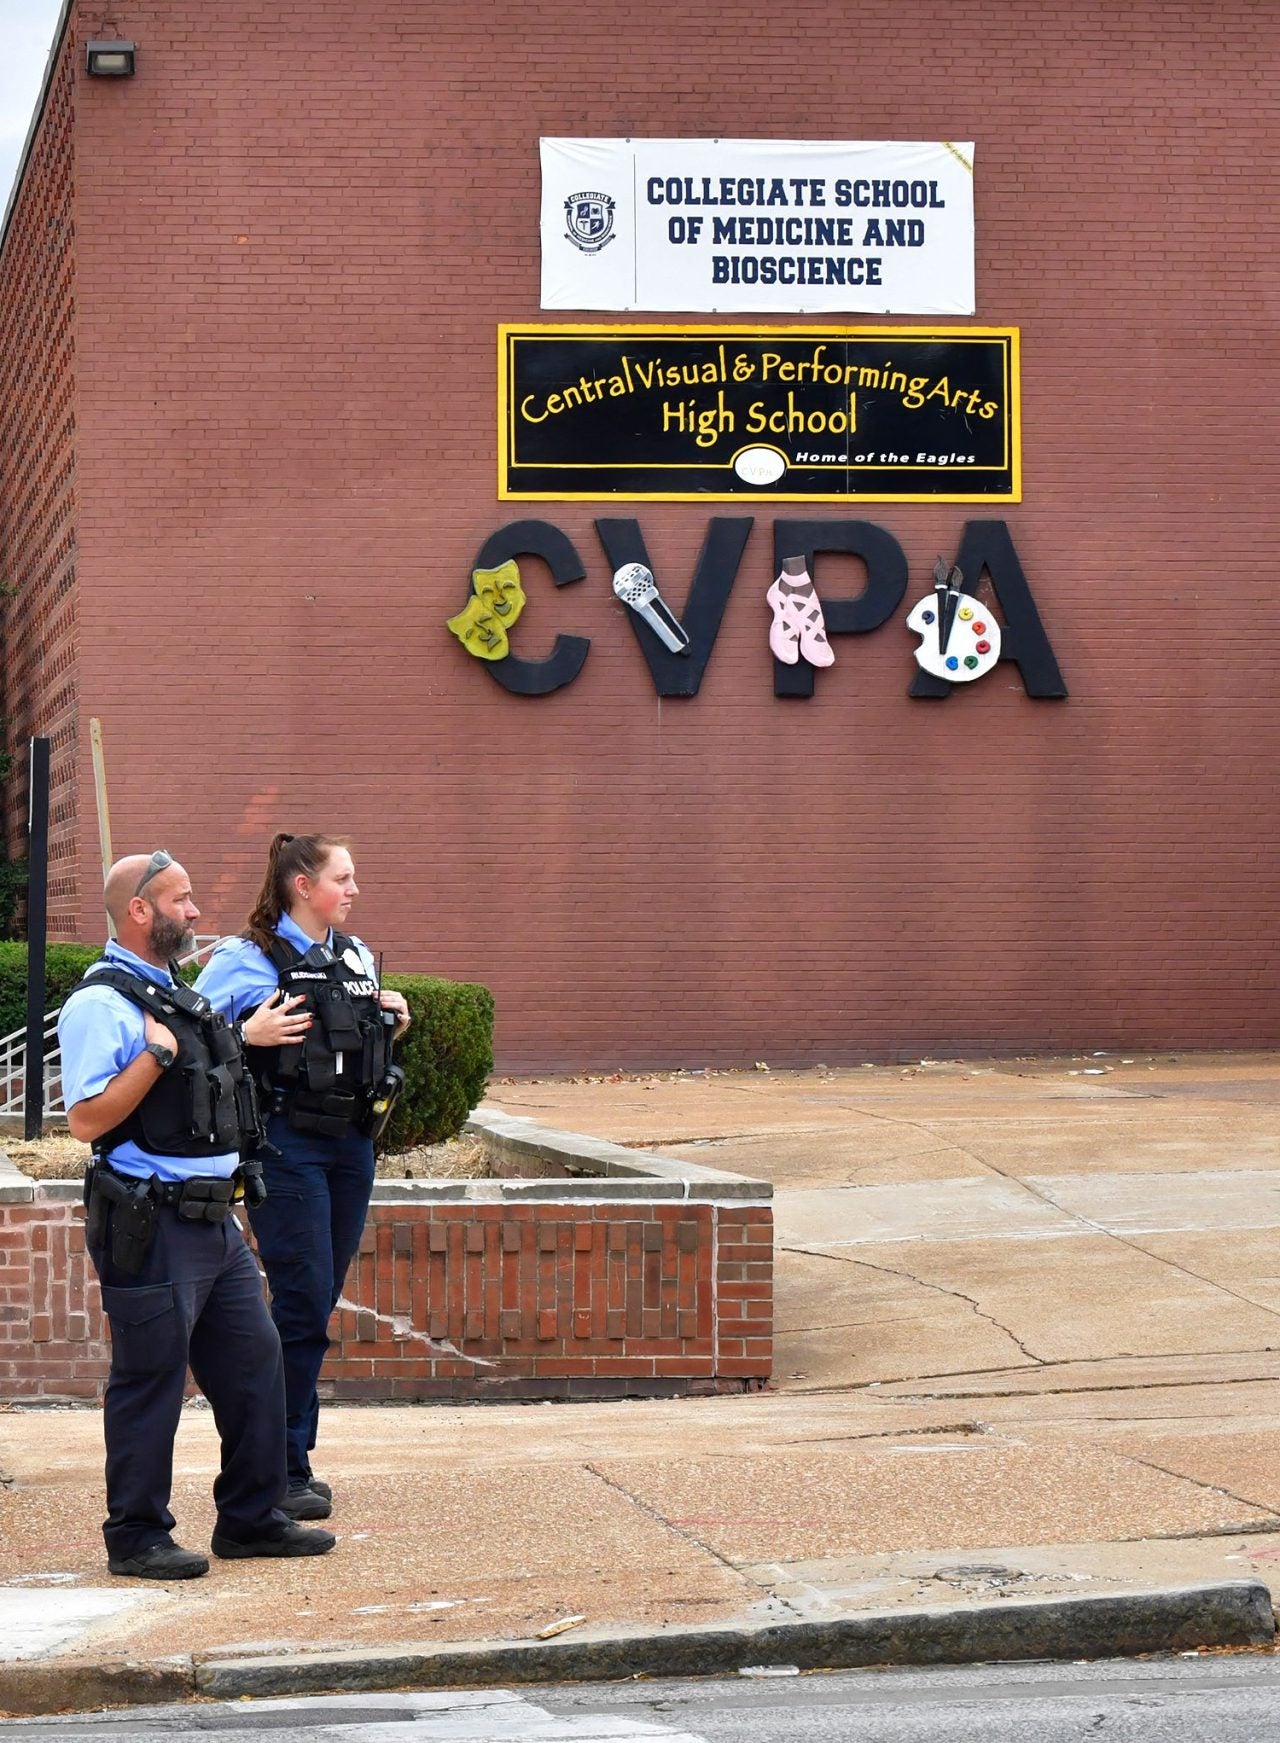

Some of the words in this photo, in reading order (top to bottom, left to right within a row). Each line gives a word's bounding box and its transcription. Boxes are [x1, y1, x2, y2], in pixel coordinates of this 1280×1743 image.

[570, 192, 609, 203] COLLEGIATE
[647, 177, 826, 207] COLLEGIATE
[835, 179, 945, 208] SCHOOL
[668, 216, 703, 244] OF
[712, 216, 853, 246] MEDICINE
[862, 218, 925, 247] AND
[712, 256, 882, 285] BIOSCIENCE
[521, 356, 634, 423] Central
[634, 344, 727, 389] Visual
[732, 353, 756, 382] &
[762, 345, 929, 409] Performing
[926, 376, 999, 419] Arts
[663, 390, 735, 447] High
[745, 391, 857, 433] School
[795, 452, 848, 463] Home
[854, 452, 875, 463] of
[880, 453, 910, 463] the
[916, 453, 976, 465] Eagles
[470, 517, 1068, 700] CVPA
[343, 980, 375, 996] POLICE
